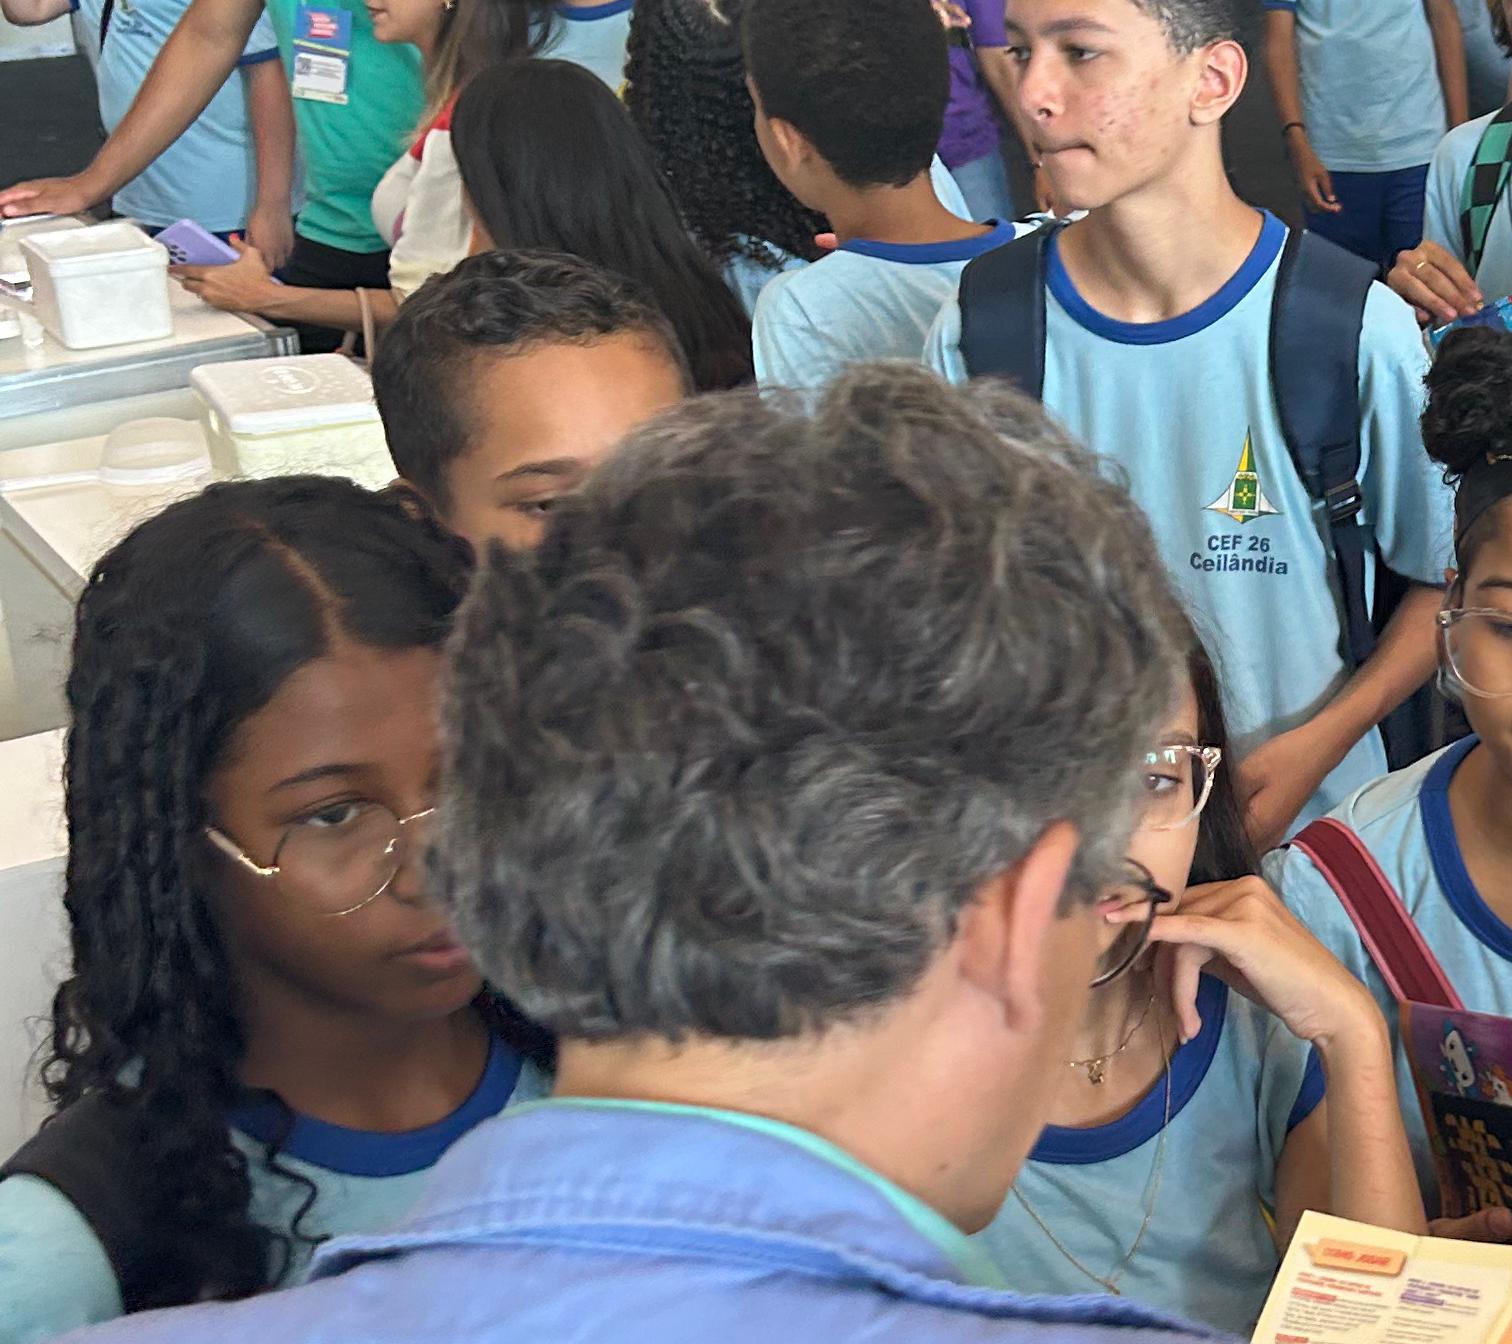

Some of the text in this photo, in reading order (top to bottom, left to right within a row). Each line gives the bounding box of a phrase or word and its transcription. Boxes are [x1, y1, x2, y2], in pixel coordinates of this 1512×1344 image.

[1207, 534, 1271, 553] CEF 26
[1189, 551, 1289, 575] Ceilândia
